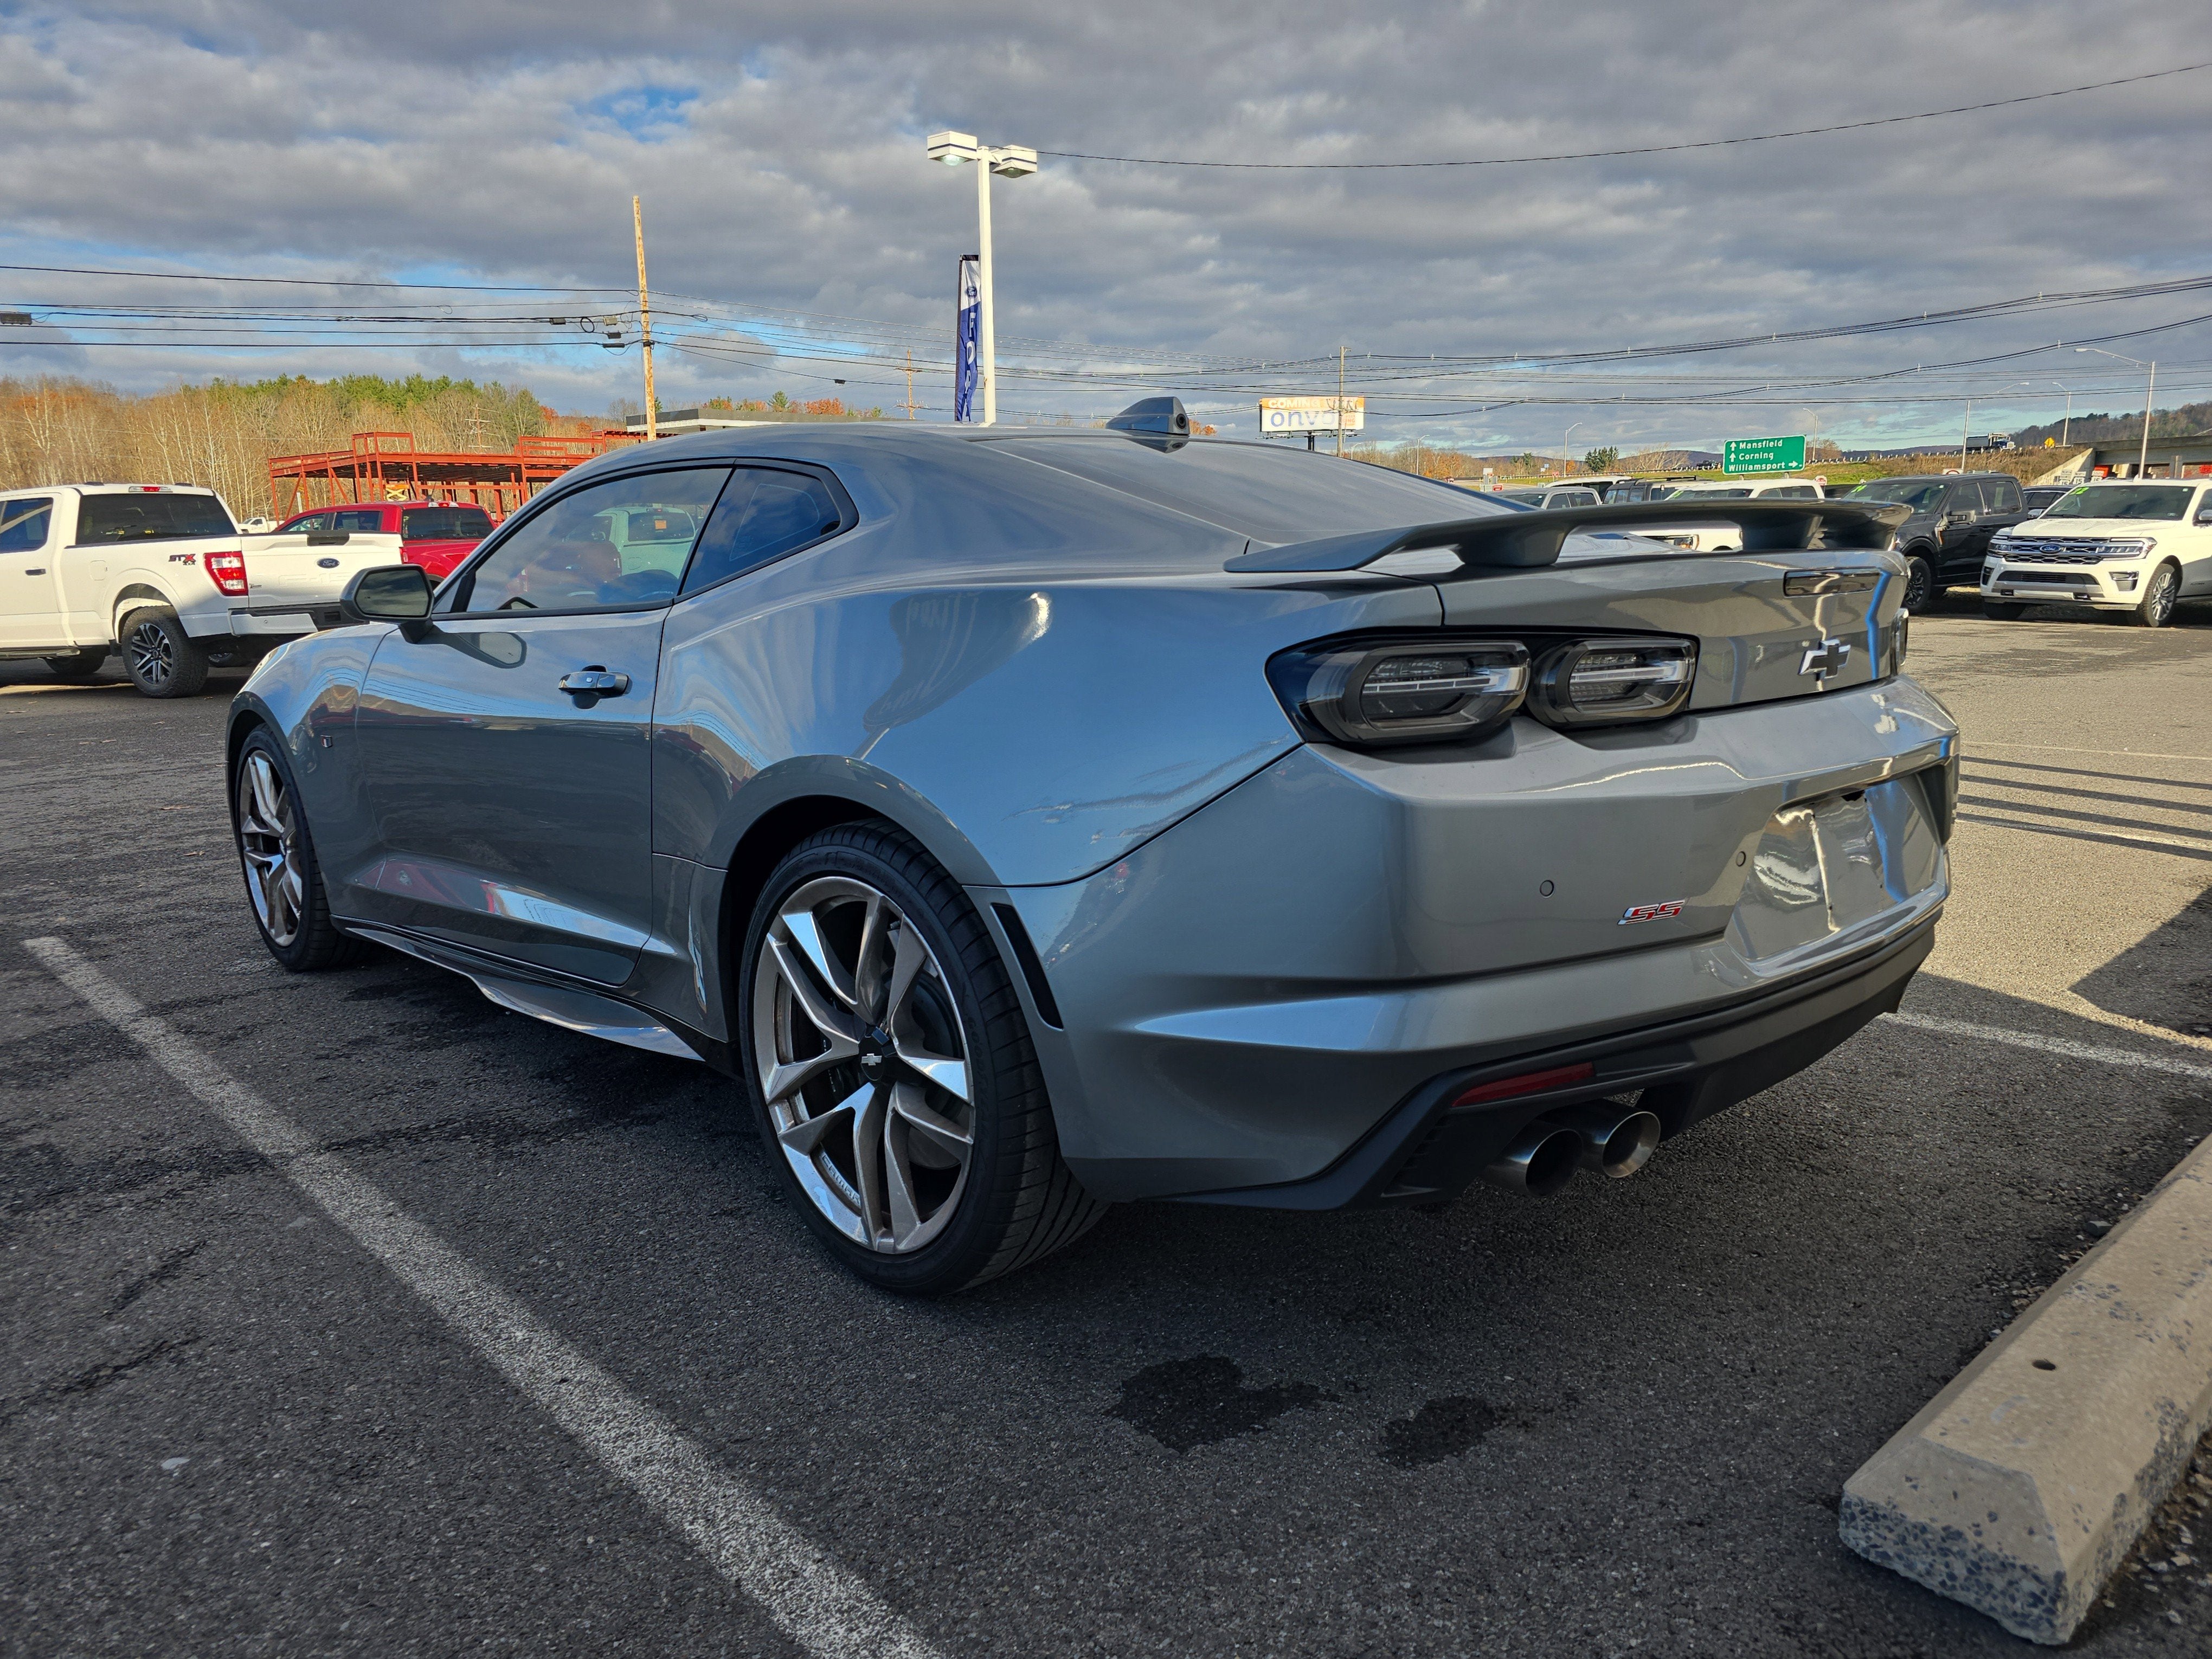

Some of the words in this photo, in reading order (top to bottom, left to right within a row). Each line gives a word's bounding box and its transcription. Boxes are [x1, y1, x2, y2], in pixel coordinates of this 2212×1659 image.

[1268, 398, 1321, 409] COMING
[1270, 411, 1336, 427] onvo
[1739, 440, 1783, 449] Mansfield
[1739, 452, 1773, 460] Corning
[1729, 461, 1785, 472] Williamsport
[169, 554, 196, 563] STX
[1617, 899, 1685, 925] SS
[822, 1154, 860, 1205] CAMAR
